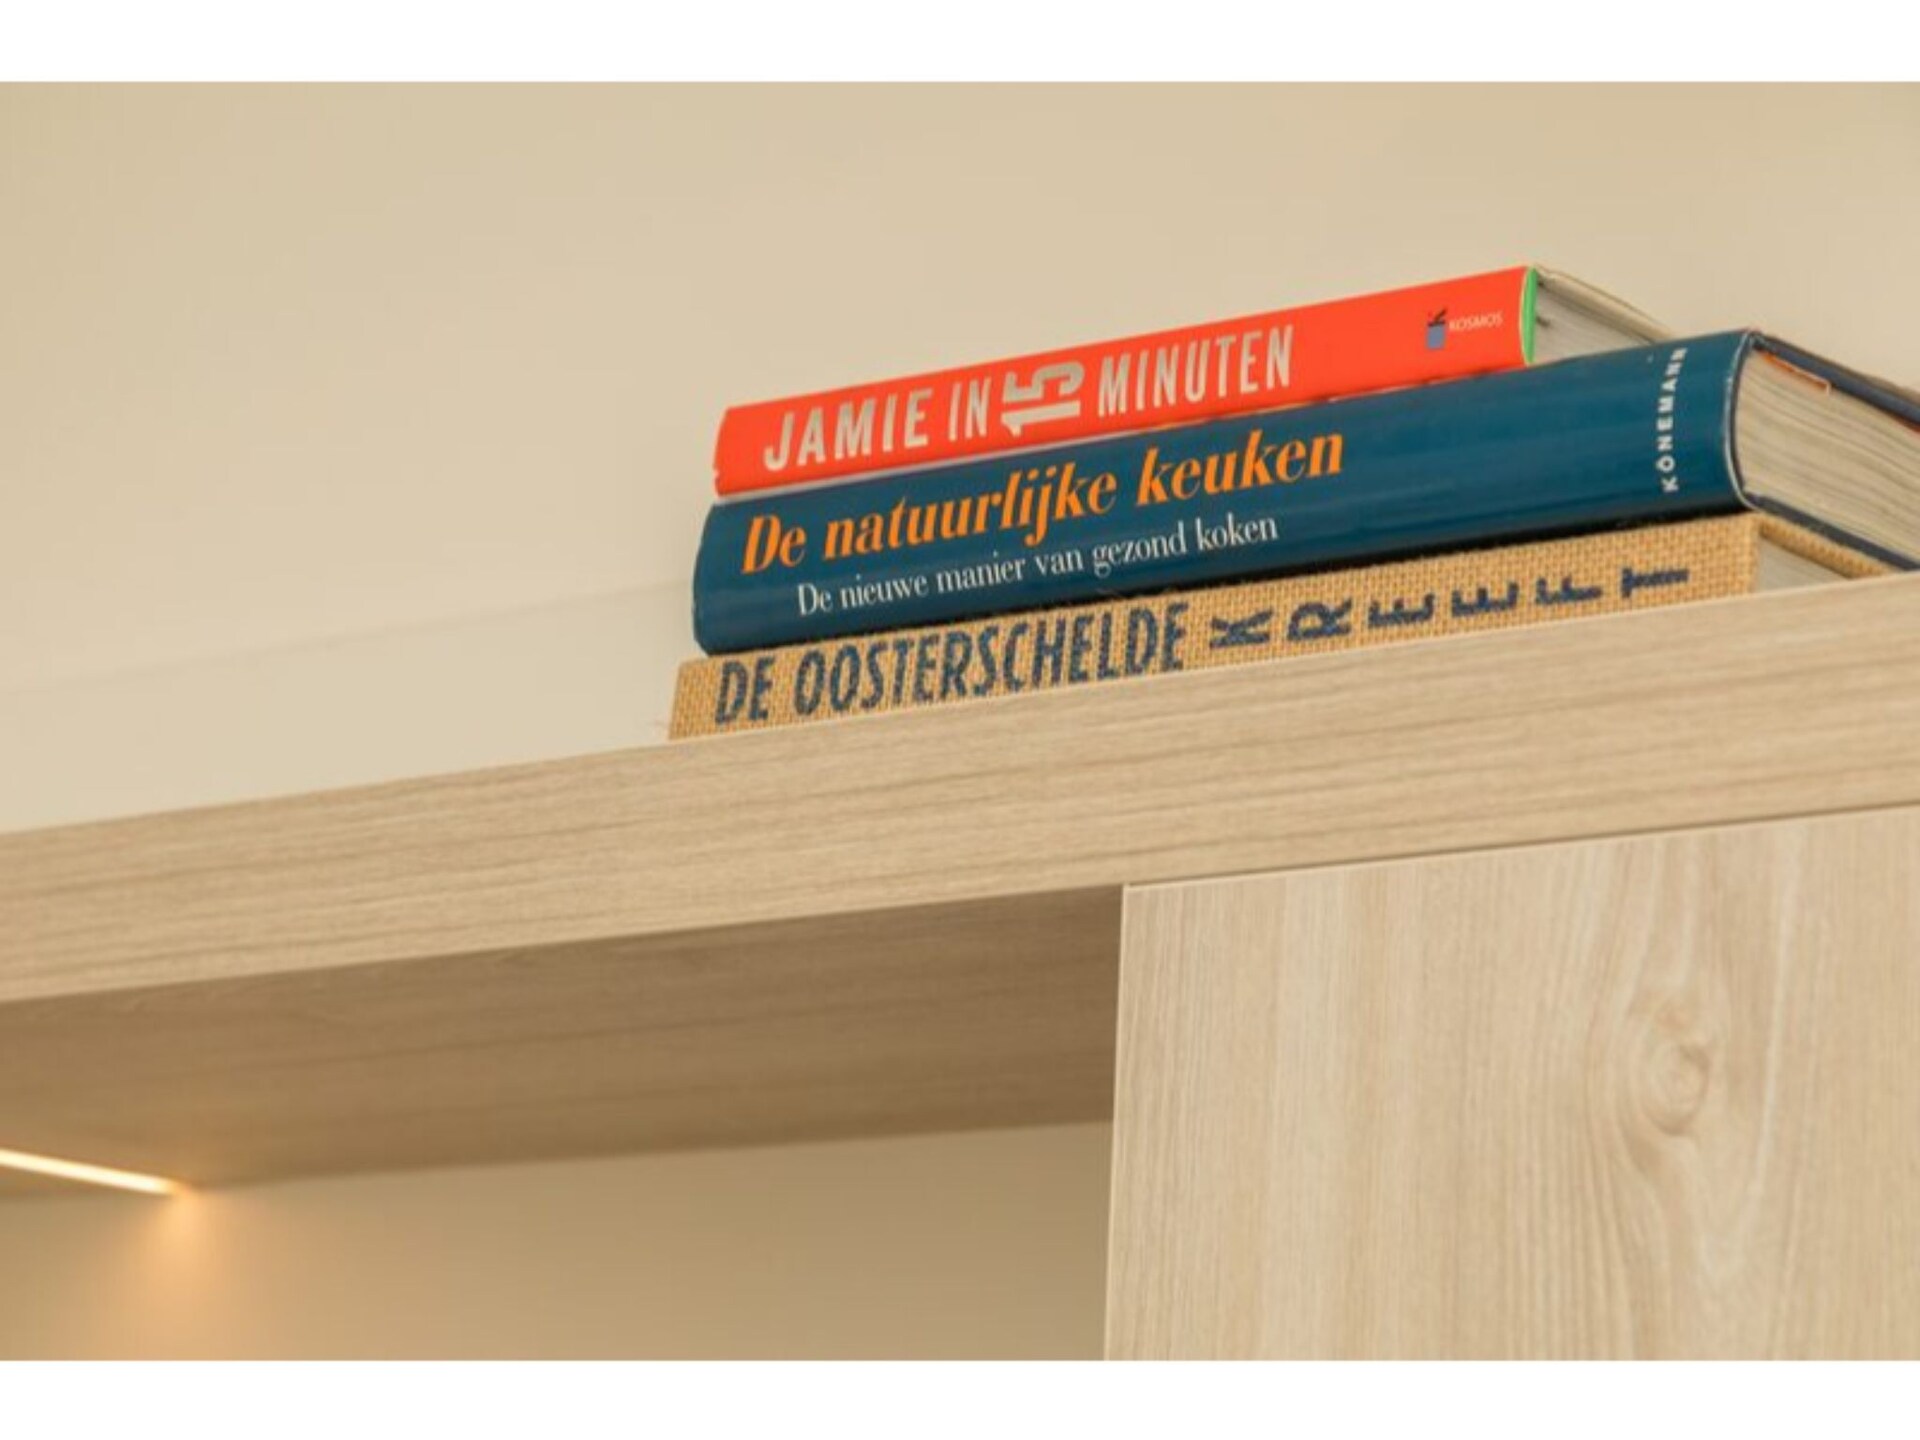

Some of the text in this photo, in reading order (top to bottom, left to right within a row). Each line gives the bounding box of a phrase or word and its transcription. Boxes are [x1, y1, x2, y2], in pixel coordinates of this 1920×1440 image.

[1448, 310, 1503, 331] KOSMOS
[763, 324, 1294, 471] JAMIE IN 15 MINUTEN
[742, 430, 1345, 574] De natuurlijke keuken
[797, 512, 1279, 617] De nieuwe manier van gezond koken
[714, 656, 776, 725] DE
[793, 602, 1189, 716] OOSTERSCHELDE
